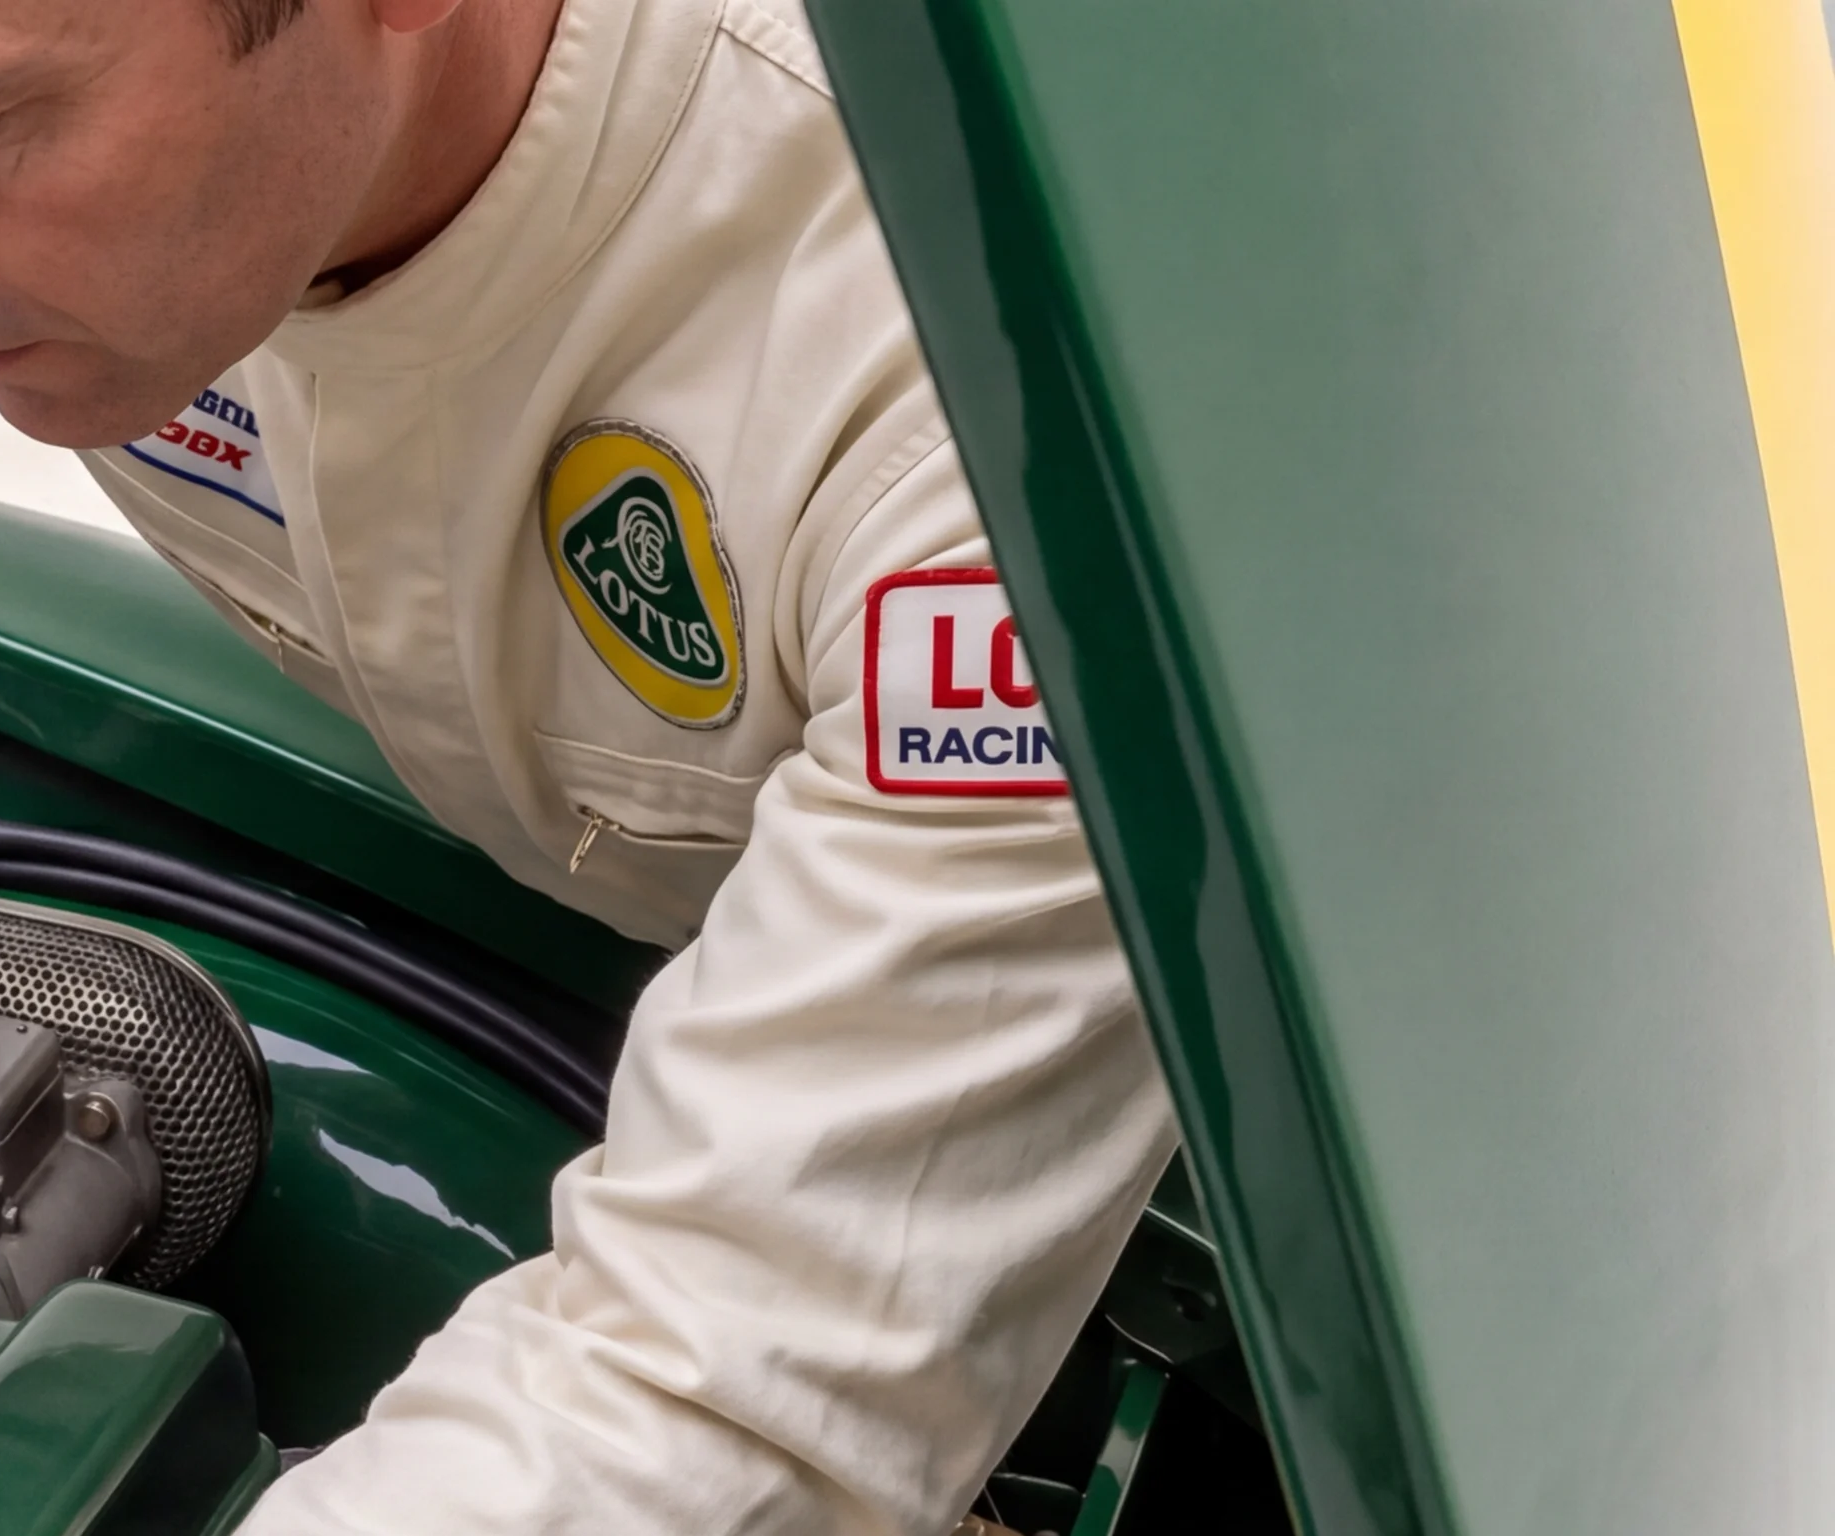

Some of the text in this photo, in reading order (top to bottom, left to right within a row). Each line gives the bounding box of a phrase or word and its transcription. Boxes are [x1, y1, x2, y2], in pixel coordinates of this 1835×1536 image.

[573, 535, 717, 668] LOTUS
[931, 615, 1040, 709] LO
[898, 726, 1064, 766] RACIN
